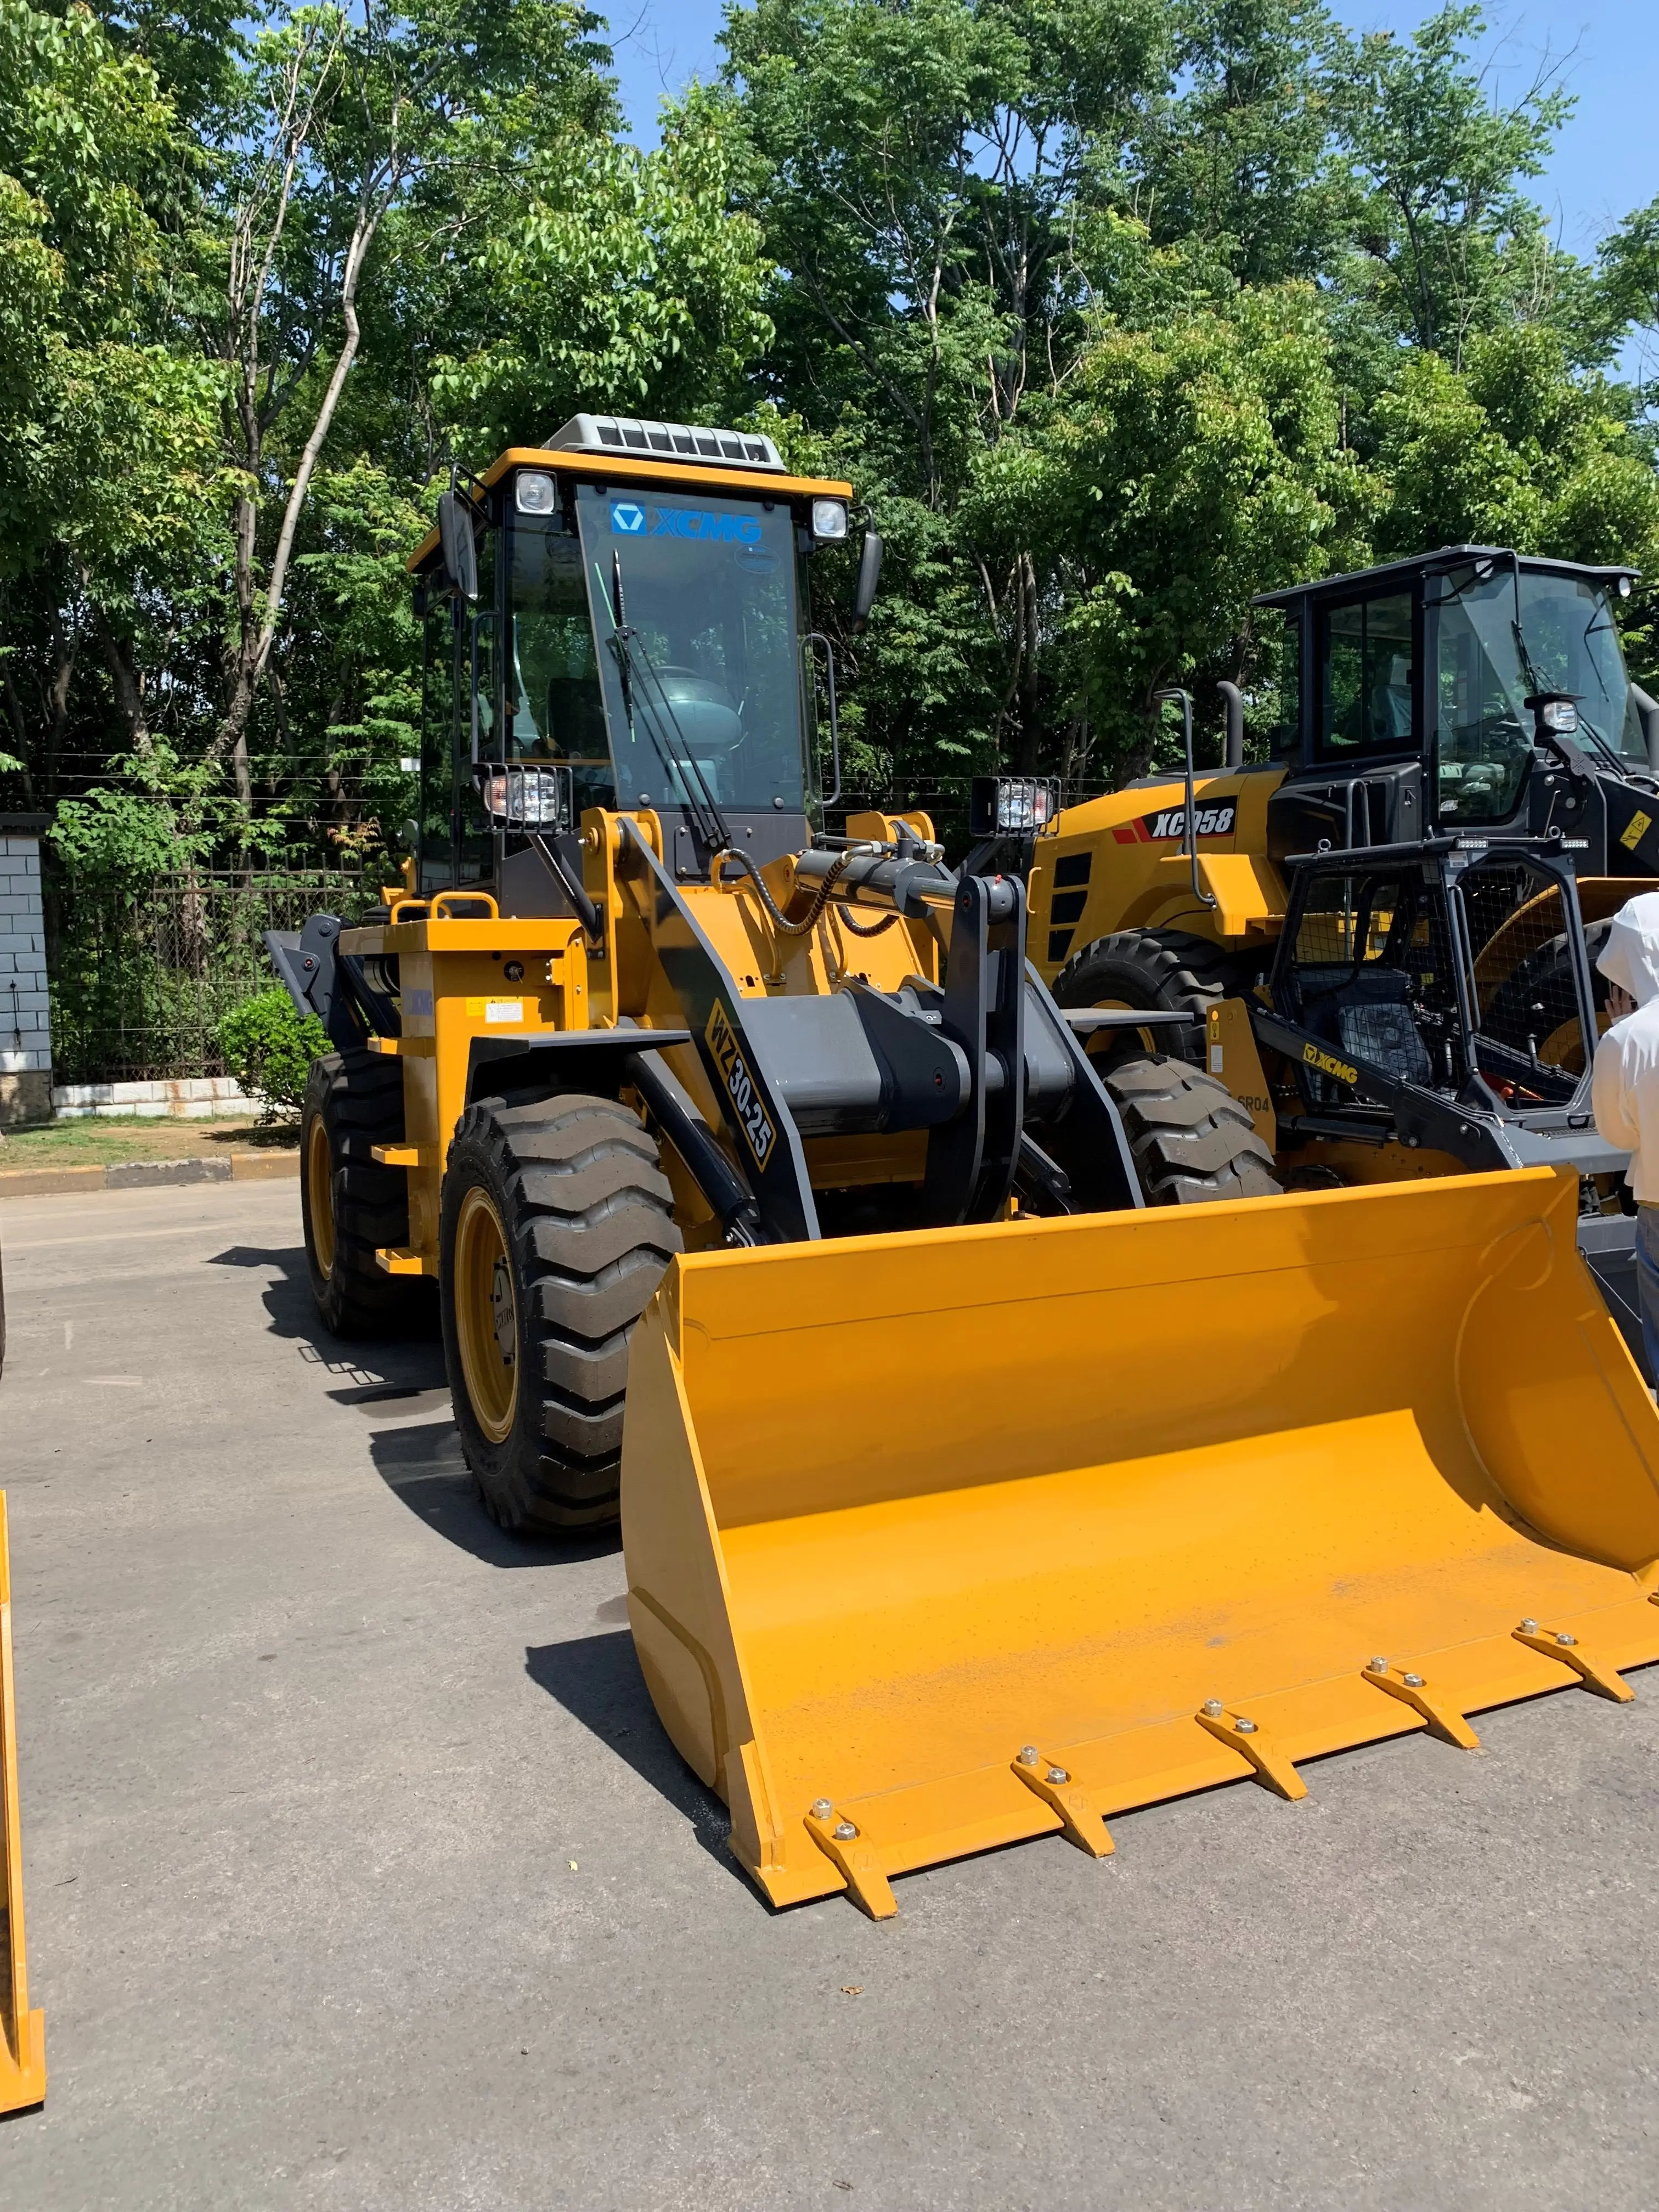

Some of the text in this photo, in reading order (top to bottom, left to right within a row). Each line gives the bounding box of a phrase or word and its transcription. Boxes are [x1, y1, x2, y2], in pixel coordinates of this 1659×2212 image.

[650, 506, 762, 544] XCMG
[712, 1007, 771, 1157] WZ30-25
[1314, 1052, 1358, 1084] XCMG
